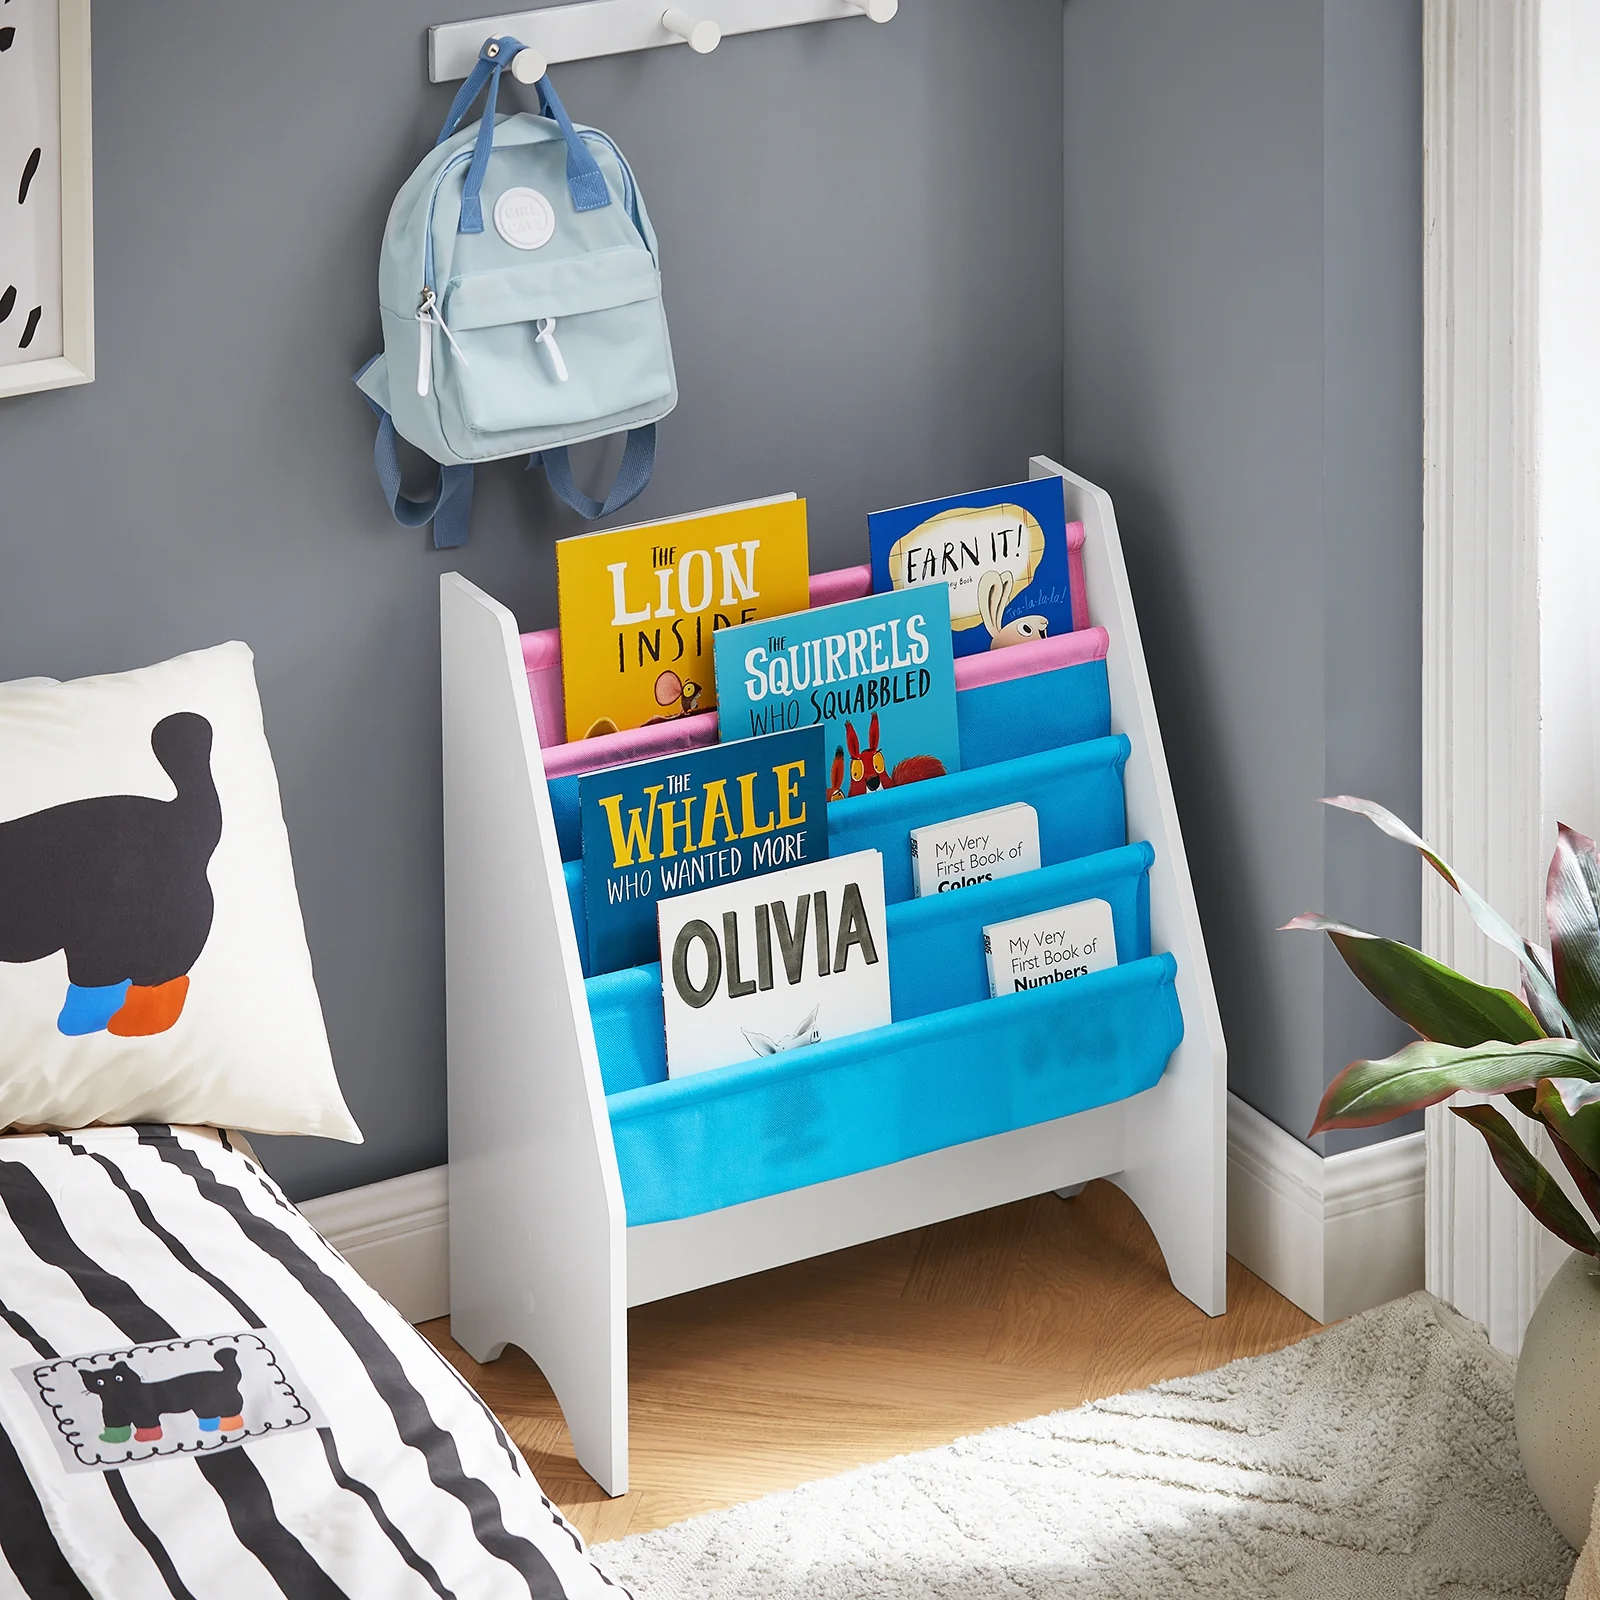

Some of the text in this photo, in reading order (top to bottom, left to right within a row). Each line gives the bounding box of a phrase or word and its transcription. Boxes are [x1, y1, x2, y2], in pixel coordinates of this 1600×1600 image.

[651, 546, 677, 568] THE
[907, 524, 1022, 584] EARN IT!
[607, 539, 760, 626] LION
[744, 614, 930, 701] SQUIRRELS
[768, 636, 787, 653] THE
[749, 668, 931, 737] WHO SQUABBLED
[666, 773, 691, 795] THE
[598, 759, 806, 869] WHALE
[935, 835, 990, 859] My Very
[936, 841, 1023, 877] First Book of
[607, 870, 652, 905] WHO
[660, 847, 742, 892] WANTED
[752, 831, 808, 871] MORE
[672, 882, 879, 1009] OLIVIA
[1009, 931, 1066, 955] My Very
[1011, 938, 1097, 974] First Book of
[1014, 965, 1088, 993] Numbers
